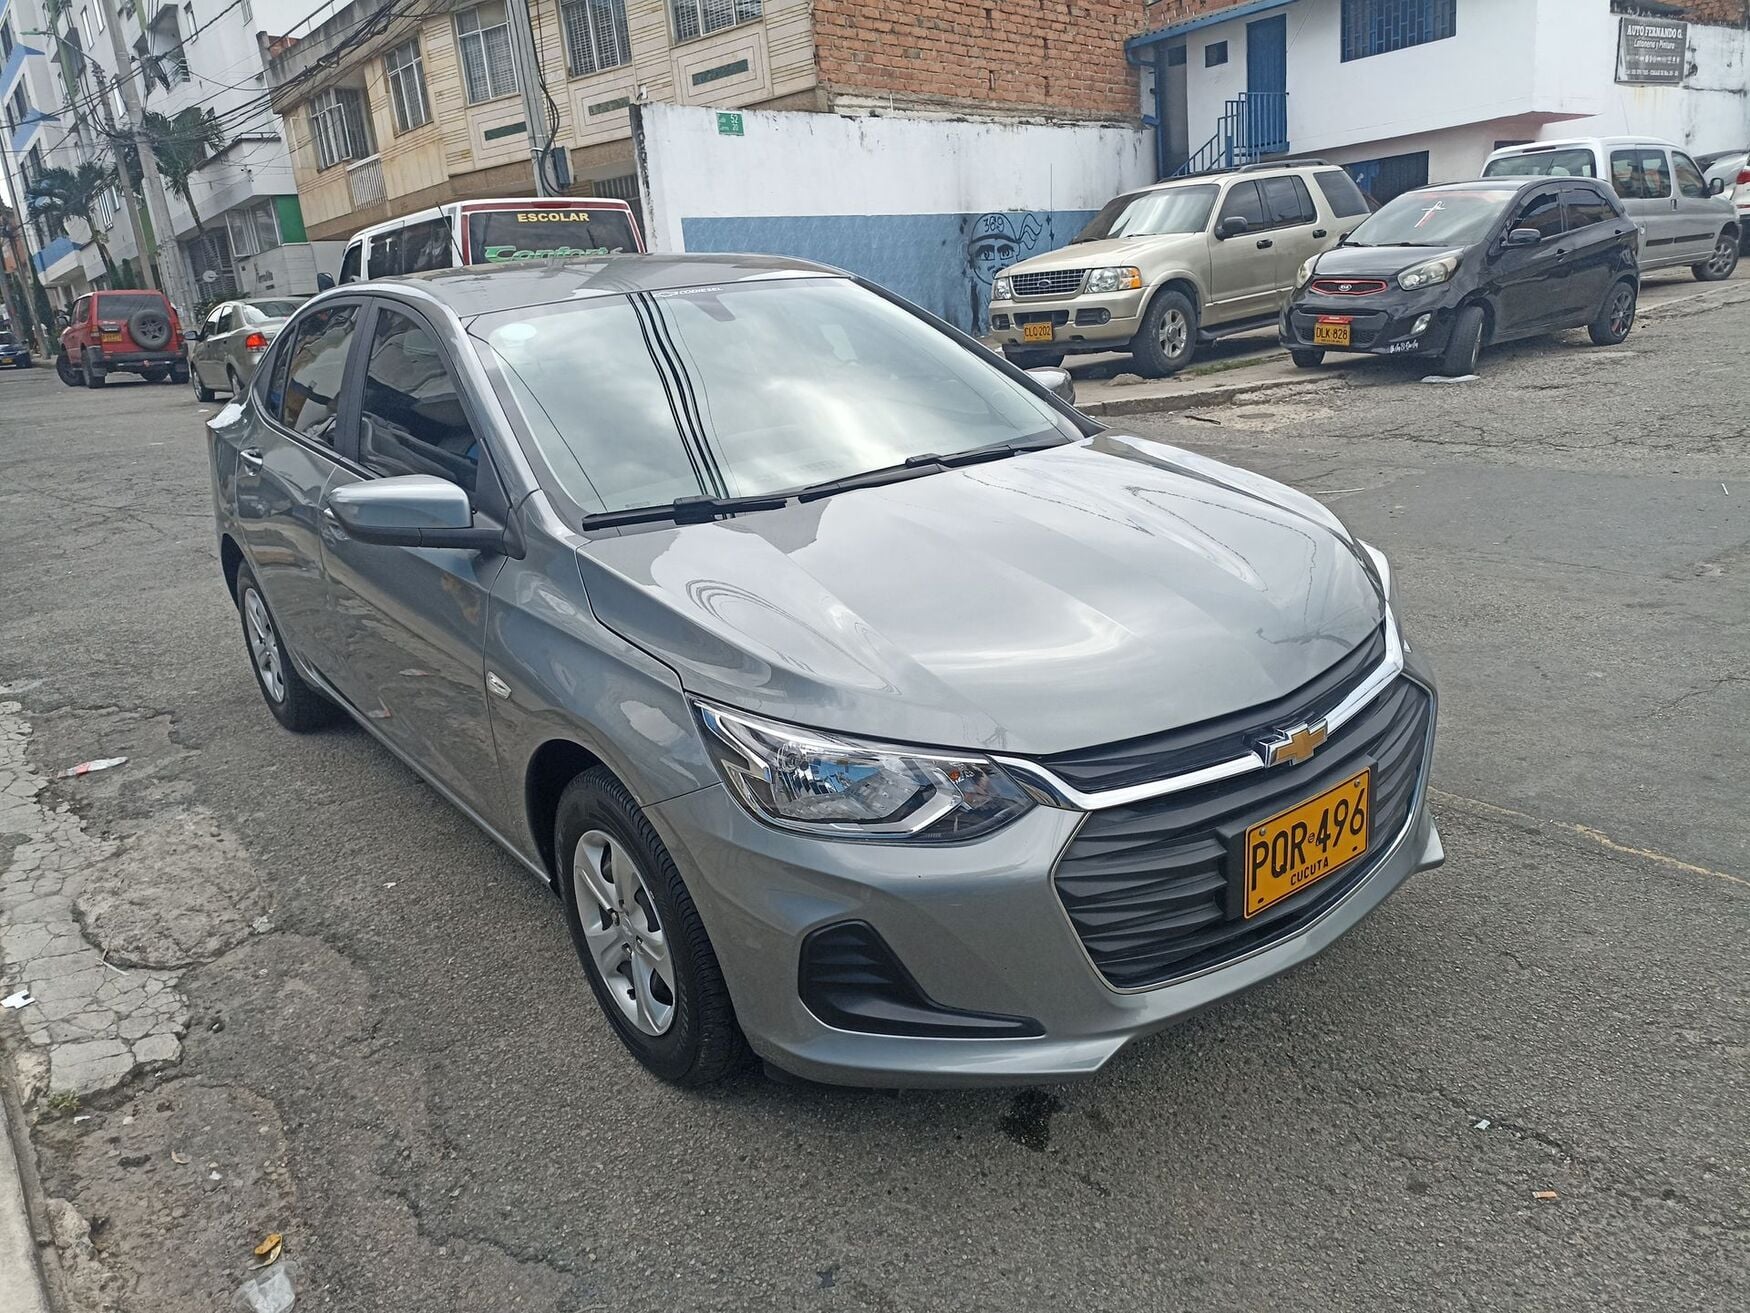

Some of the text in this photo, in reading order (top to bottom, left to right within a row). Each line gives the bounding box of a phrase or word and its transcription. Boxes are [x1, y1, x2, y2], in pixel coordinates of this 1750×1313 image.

[1626, 24, 1645, 36] AUTO
[1645, 26, 1677, 39] FERNANDO
[730, 114, 740, 124] 52
[516, 212, 590, 223] ESCOLAR
[983, 215, 1005, 233] 369
[1038, 325, 1051, 336] 202
[1316, 327, 1348, 340] DLK 828
[1251, 788, 1366, 892] PQR 496
[1290, 856, 1329, 886] CUCUTA
